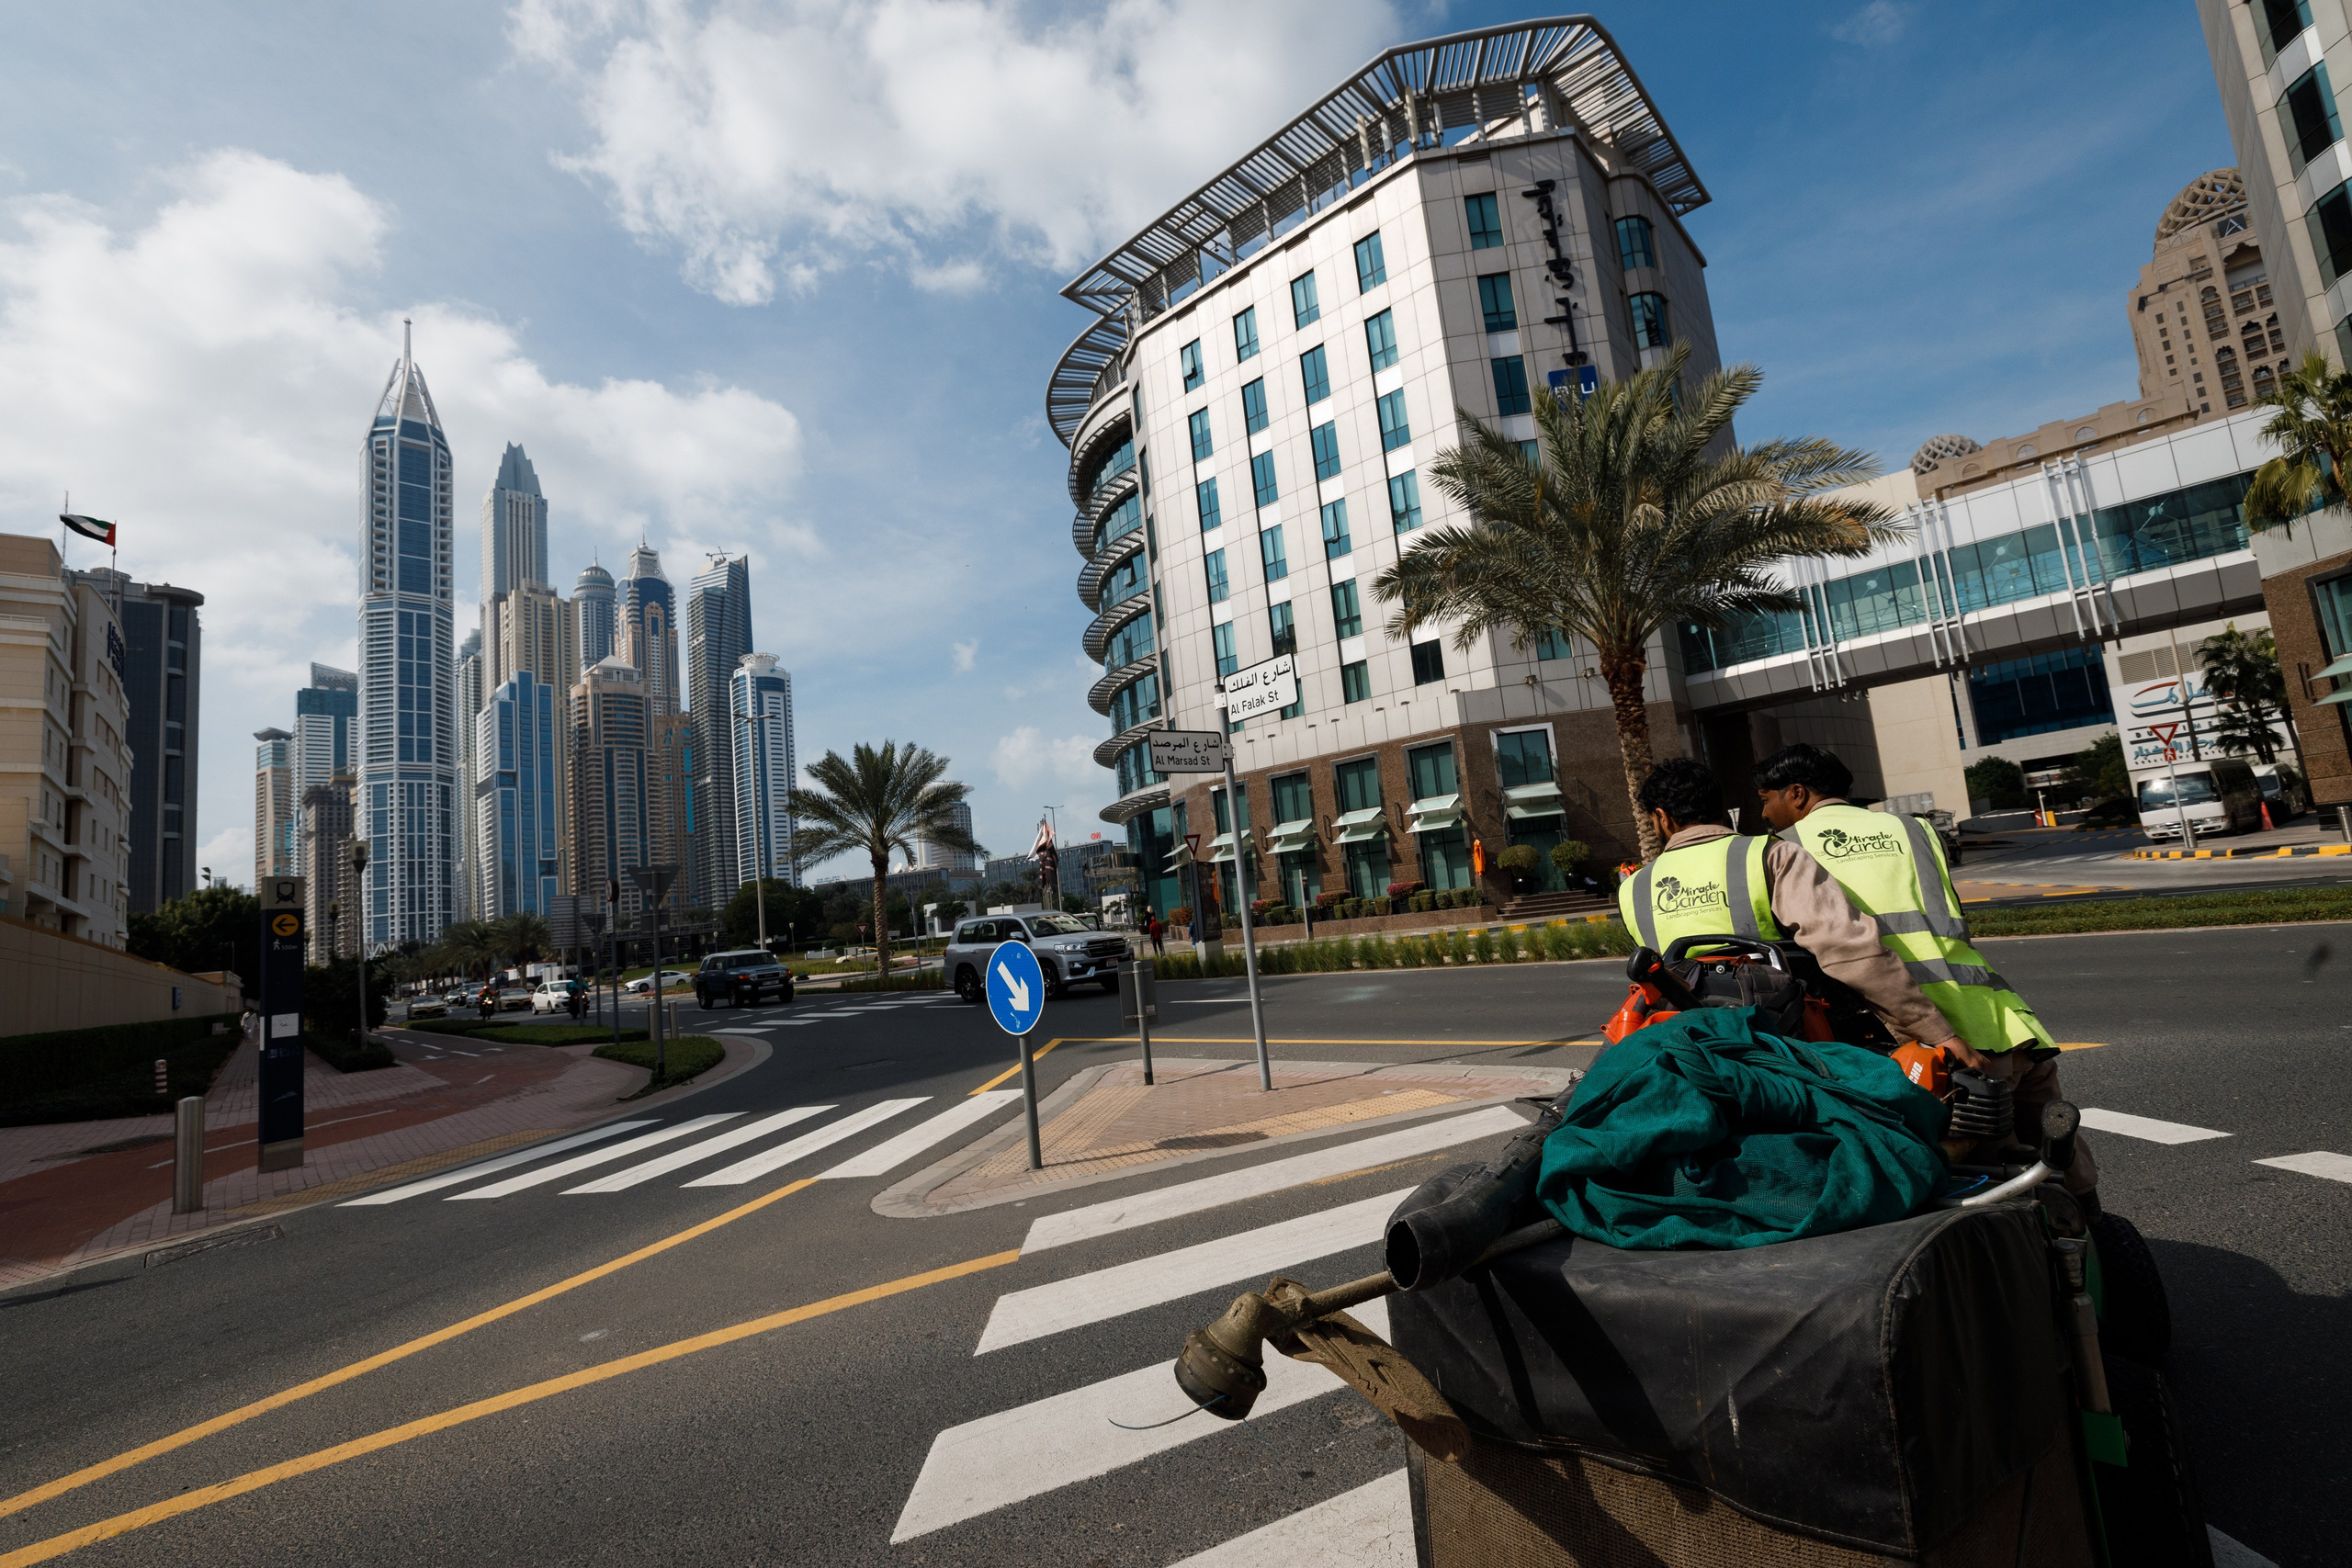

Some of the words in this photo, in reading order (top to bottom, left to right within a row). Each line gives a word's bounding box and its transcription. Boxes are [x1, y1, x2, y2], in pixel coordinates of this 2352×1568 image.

[1262, 661, 1291, 686] شارع
[1228, 671, 1258, 694] الفلك
[1231, 703, 1240, 716] Al
[1242, 694, 1266, 712] Falak
[1268, 690, 1279, 703] St
[1152, 737, 1190, 751] المرصد
[1193, 738, 1220, 753] شارع
[1155, 755, 1165, 765] Al
[1167, 755, 1198, 766] Marsad
[1200, 755, 1211, 766] St
[1849, 831, 1893, 844] Miracle
[1823, 838, 1905, 859] Garden
[1836, 854, 1874, 864] Landscaping
[1679, 881, 1721, 897] Miracle
[1657, 887, 1730, 913] Garden
[1666, 909, 1699, 920] Landscaping
[1699, 906, 1723, 914] Services
